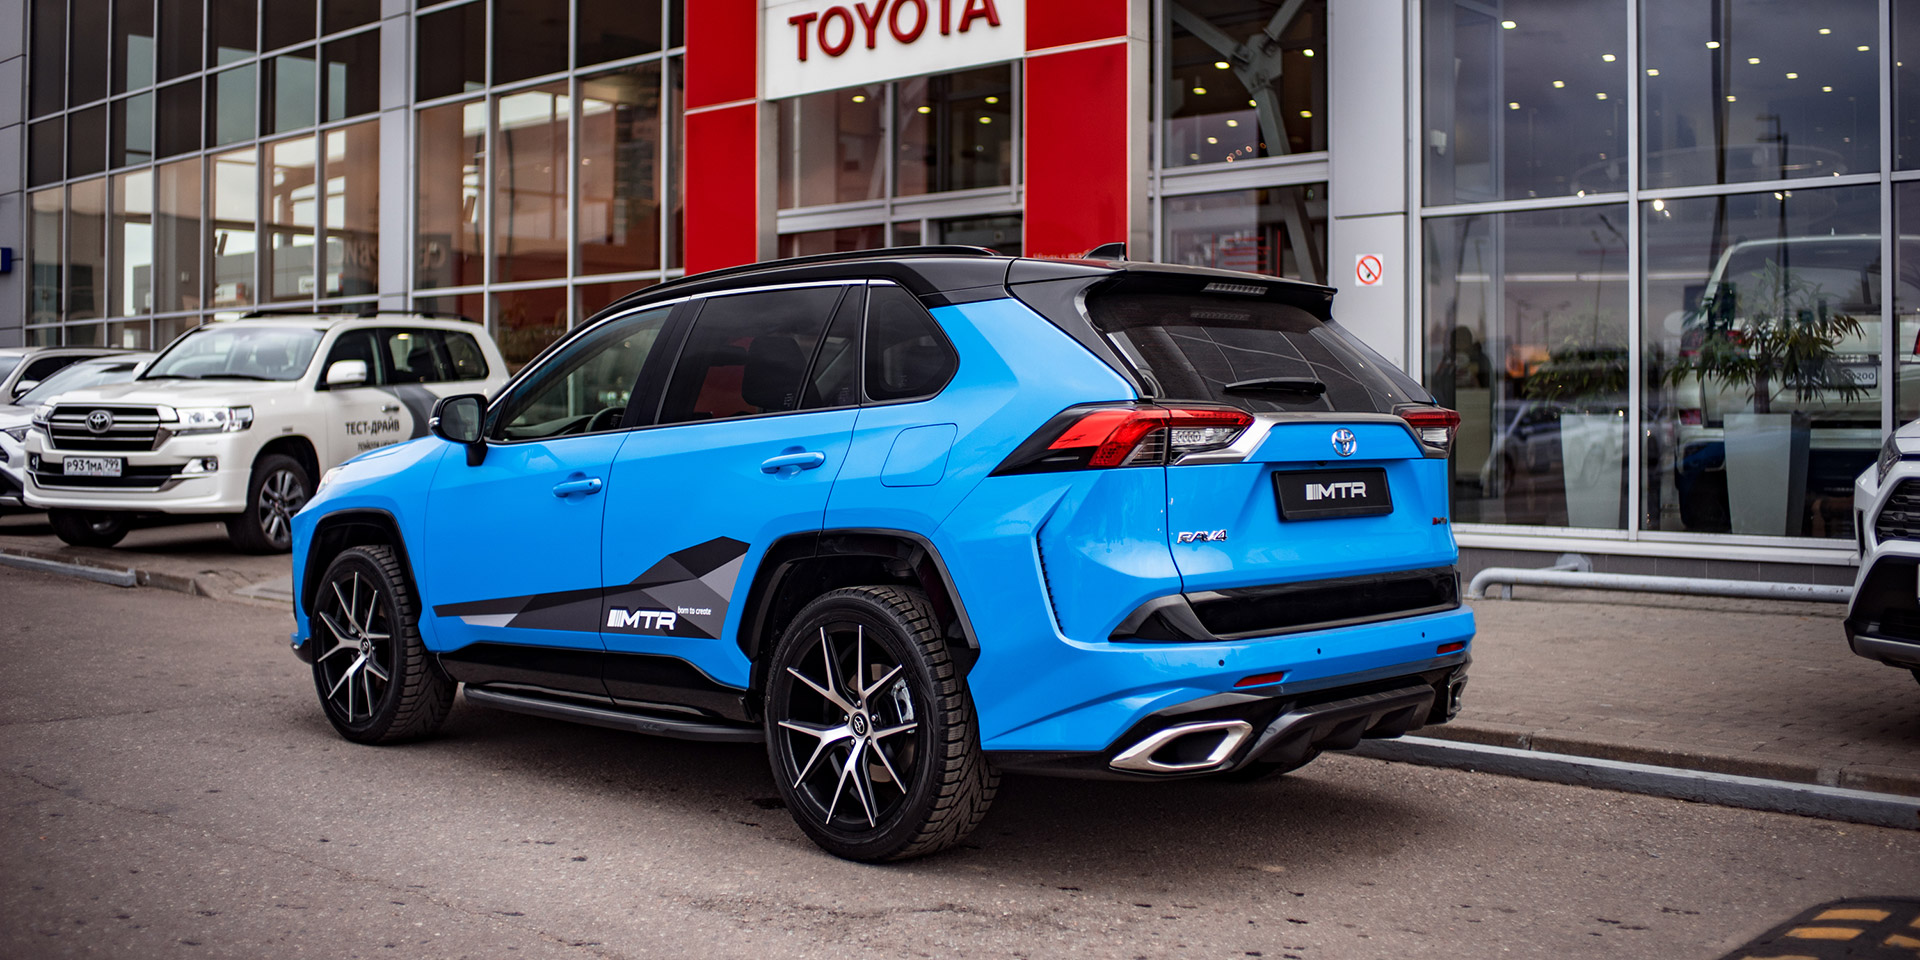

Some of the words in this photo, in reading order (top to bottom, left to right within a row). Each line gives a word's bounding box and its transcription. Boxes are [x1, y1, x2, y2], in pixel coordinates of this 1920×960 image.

[788, 0, 1000, 61] TOYOTA
[345, 417, 400, 435] ТЕСТ-ДРАЙВ
[1177, 529, 1227, 544] RAV4
[677, 606, 689, 614] born
[690, 607, 695, 615] to
